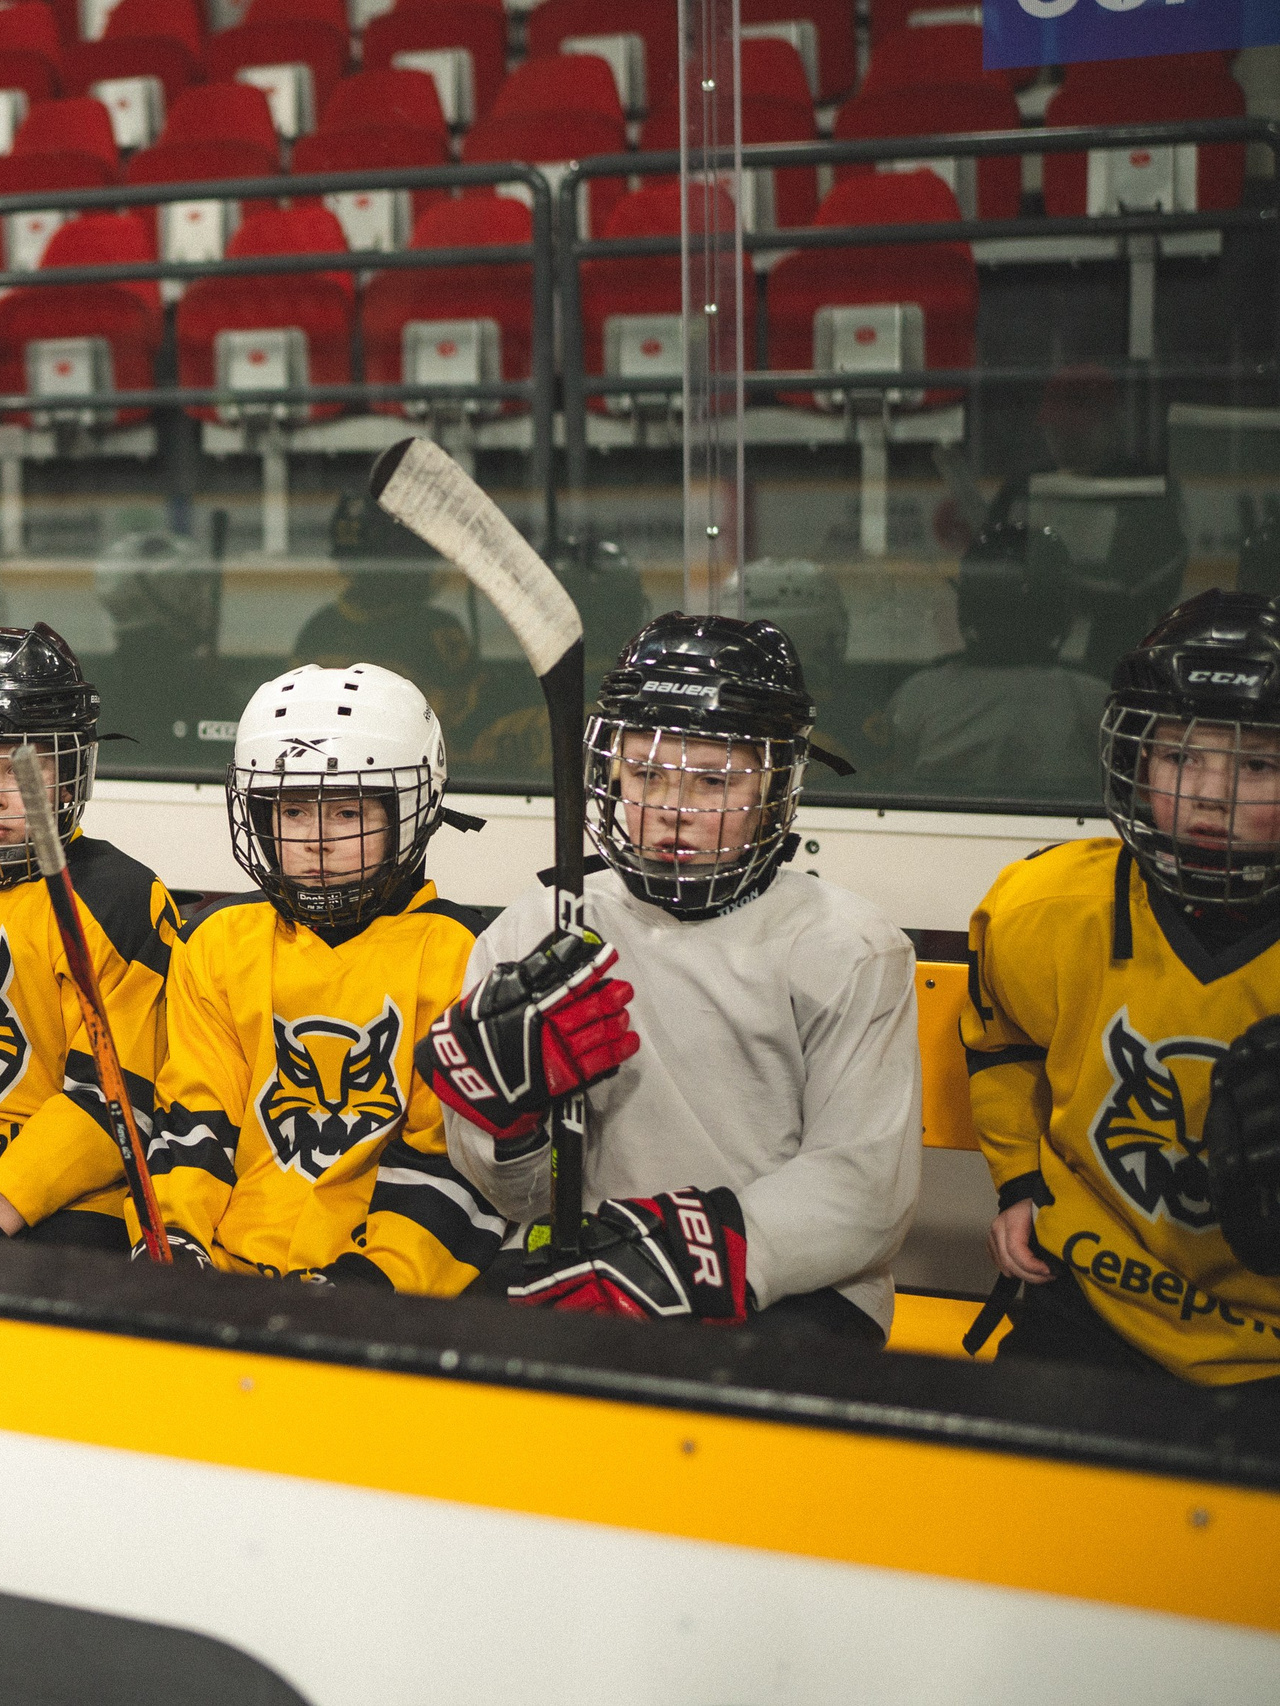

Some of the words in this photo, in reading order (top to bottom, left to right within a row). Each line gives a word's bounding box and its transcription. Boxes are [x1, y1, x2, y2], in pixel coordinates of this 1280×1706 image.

[1187, 670, 1261, 686] CCM
[642, 680, 718, 697] BAUER
[716, 887, 759, 917] TIXON
